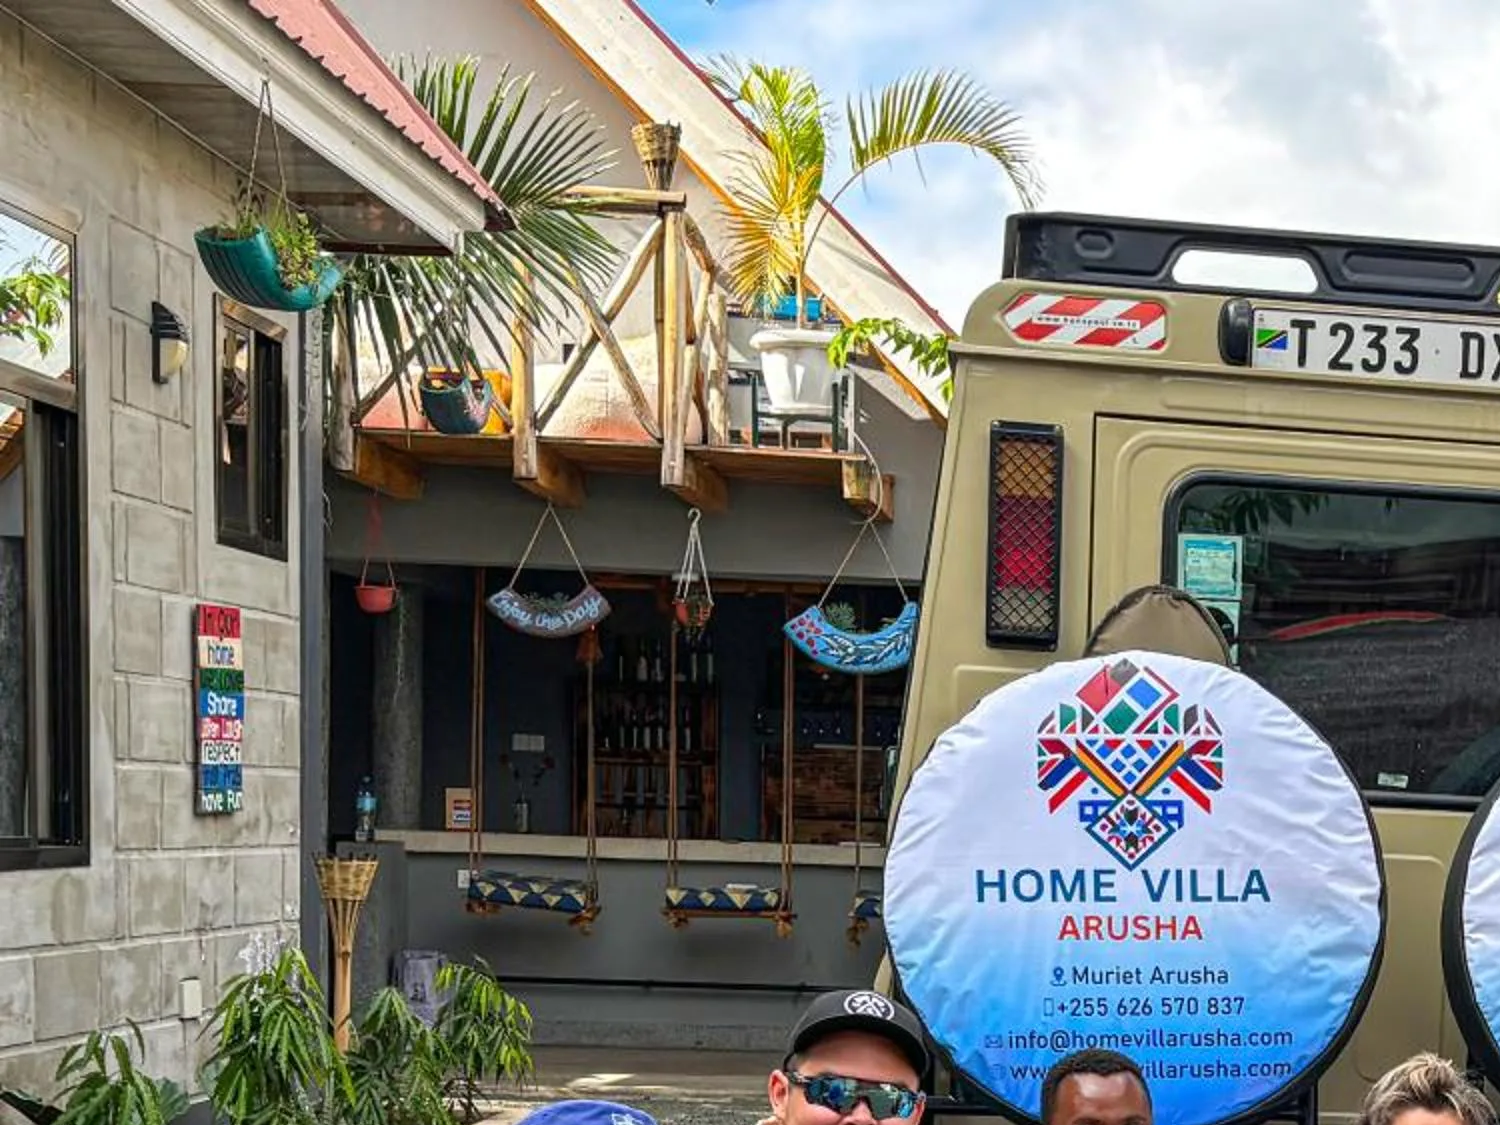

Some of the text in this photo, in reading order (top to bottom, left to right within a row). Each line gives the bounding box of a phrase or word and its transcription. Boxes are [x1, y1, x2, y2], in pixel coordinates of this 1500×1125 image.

[1290, 319, 1316, 368] T
[1328, 322, 1421, 375] 233
[975, 868, 1271, 903] HOME VILLA
[1058, 915, 1204, 941] ARUSHA
[1072, 966, 1229, 986] Muriet Arusha
[1057, 996, 1245, 1017] +255 626 570 837
[1008, 1028, 1293, 1052] info@homevillarusha.com
